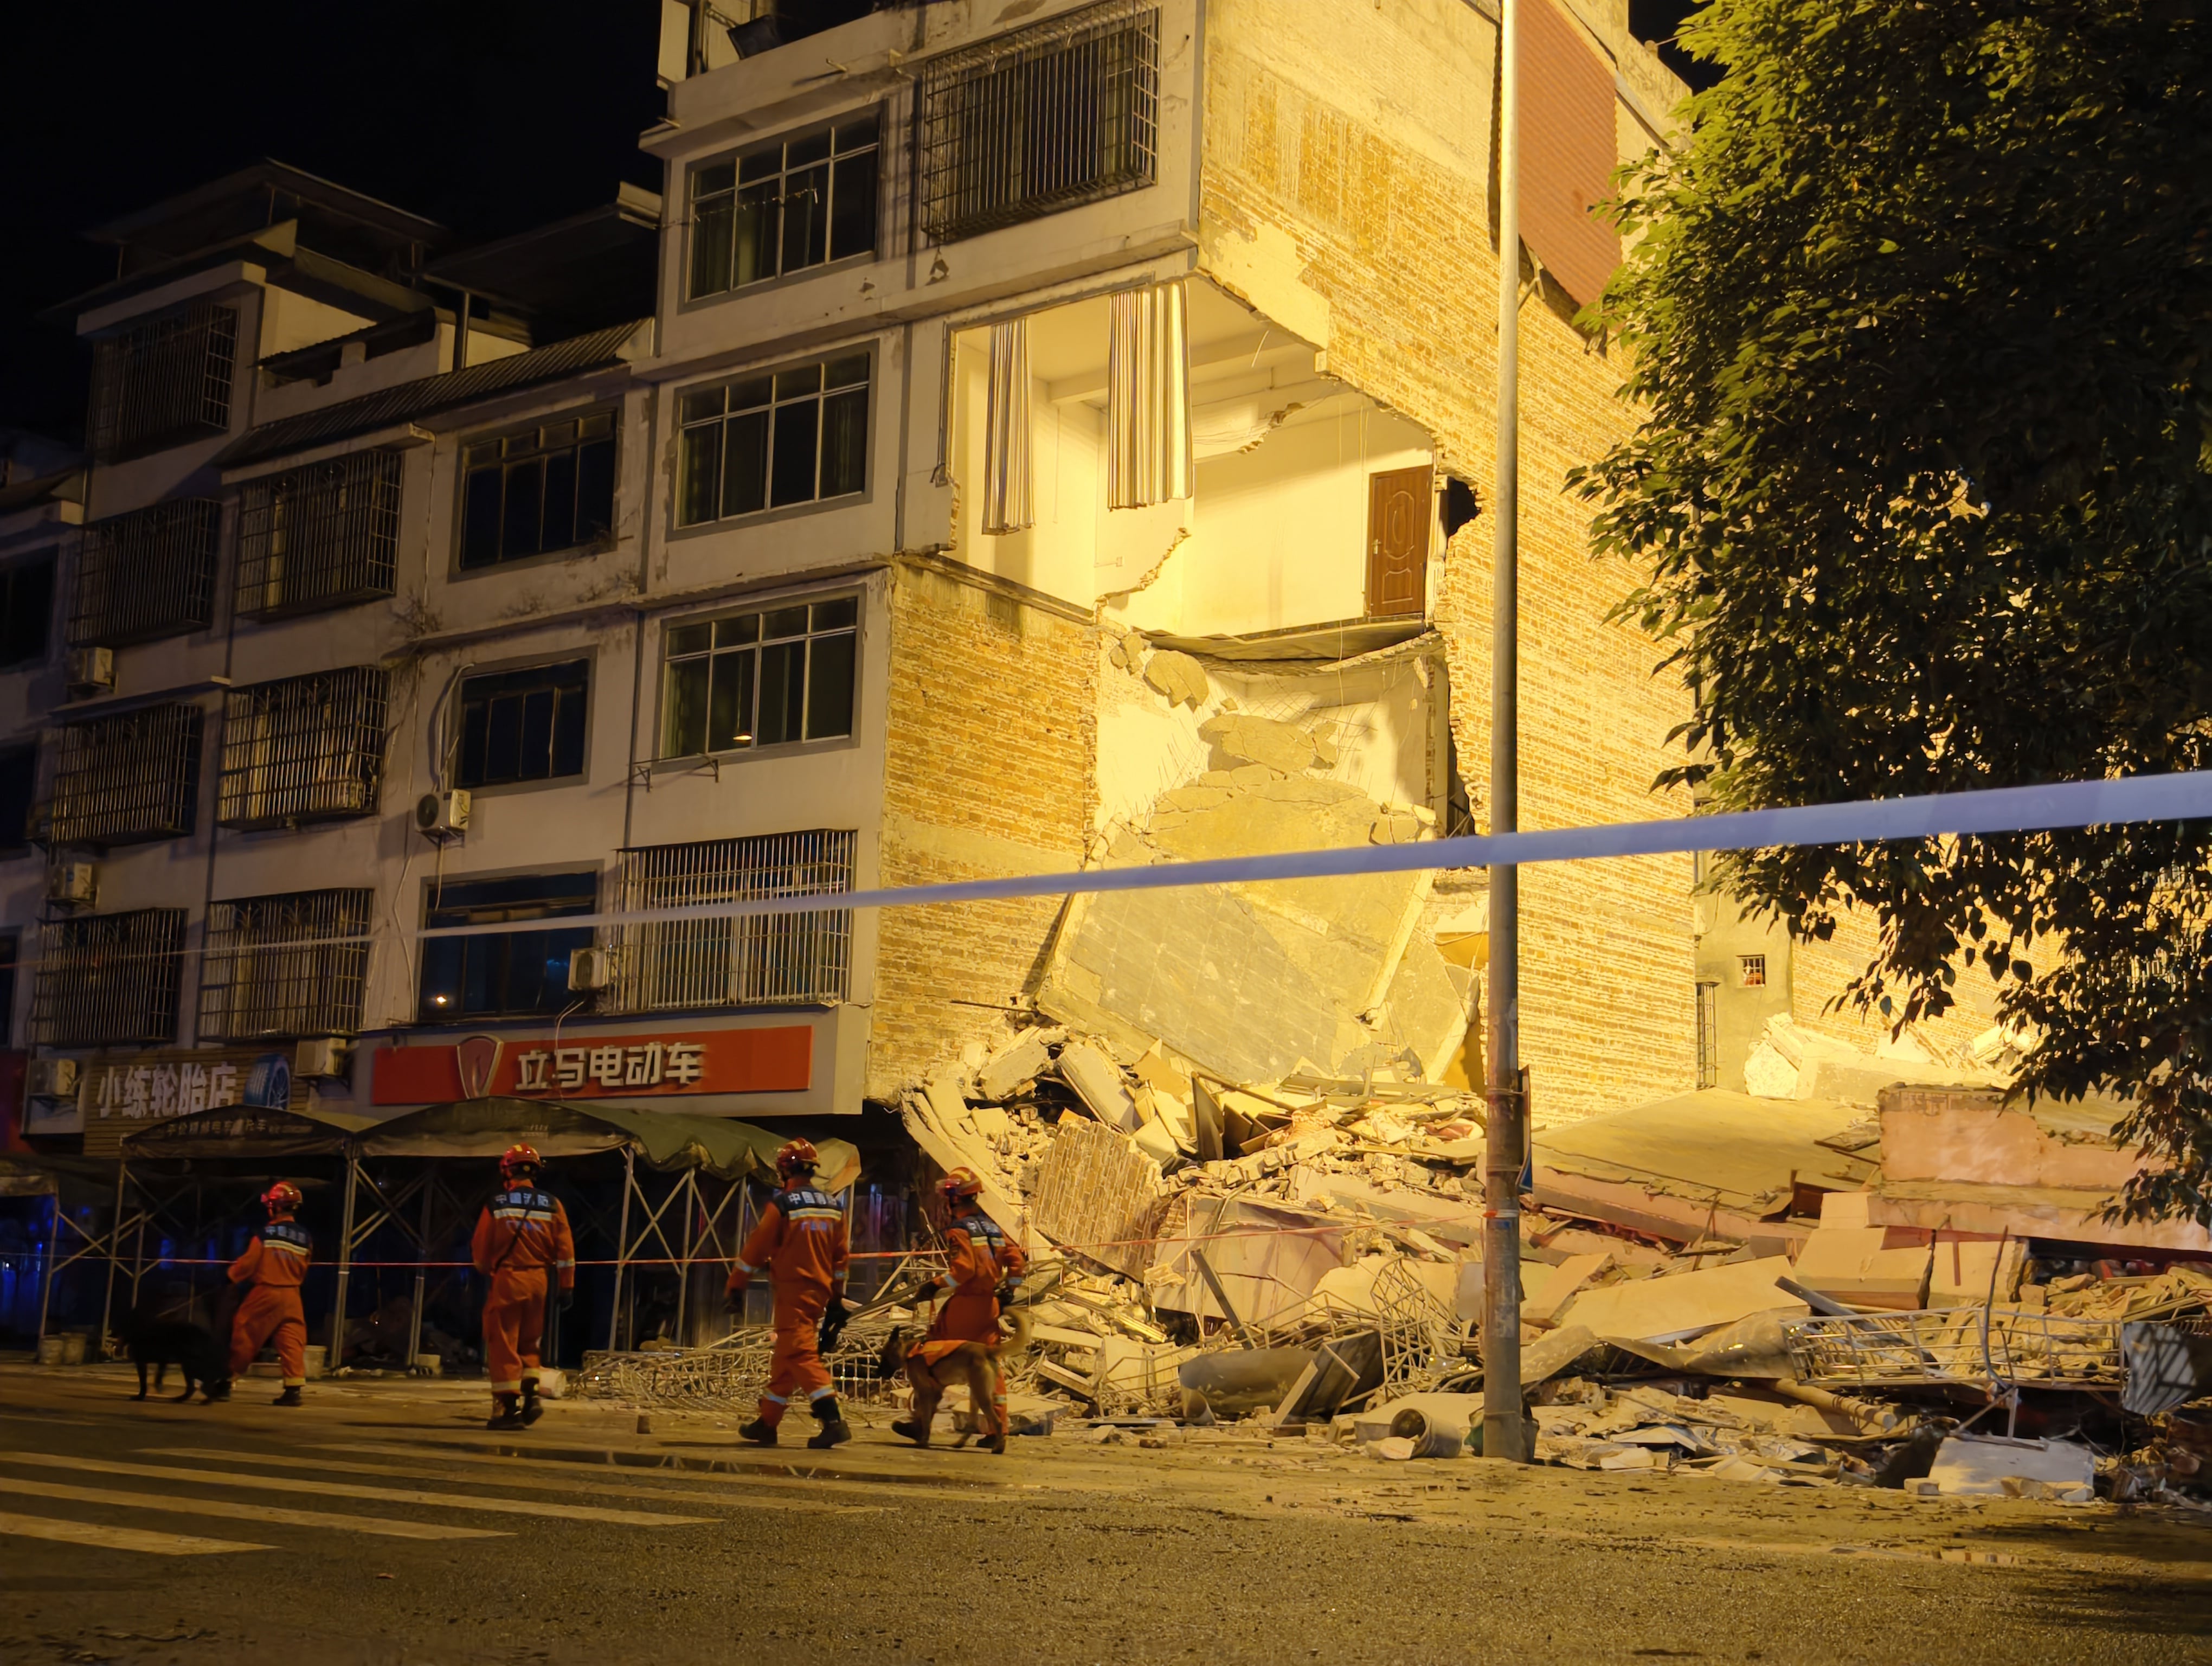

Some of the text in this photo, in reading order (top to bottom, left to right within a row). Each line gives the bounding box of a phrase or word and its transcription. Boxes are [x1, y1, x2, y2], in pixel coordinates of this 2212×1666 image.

[516, 1042, 706, 1090] 立马电动车
